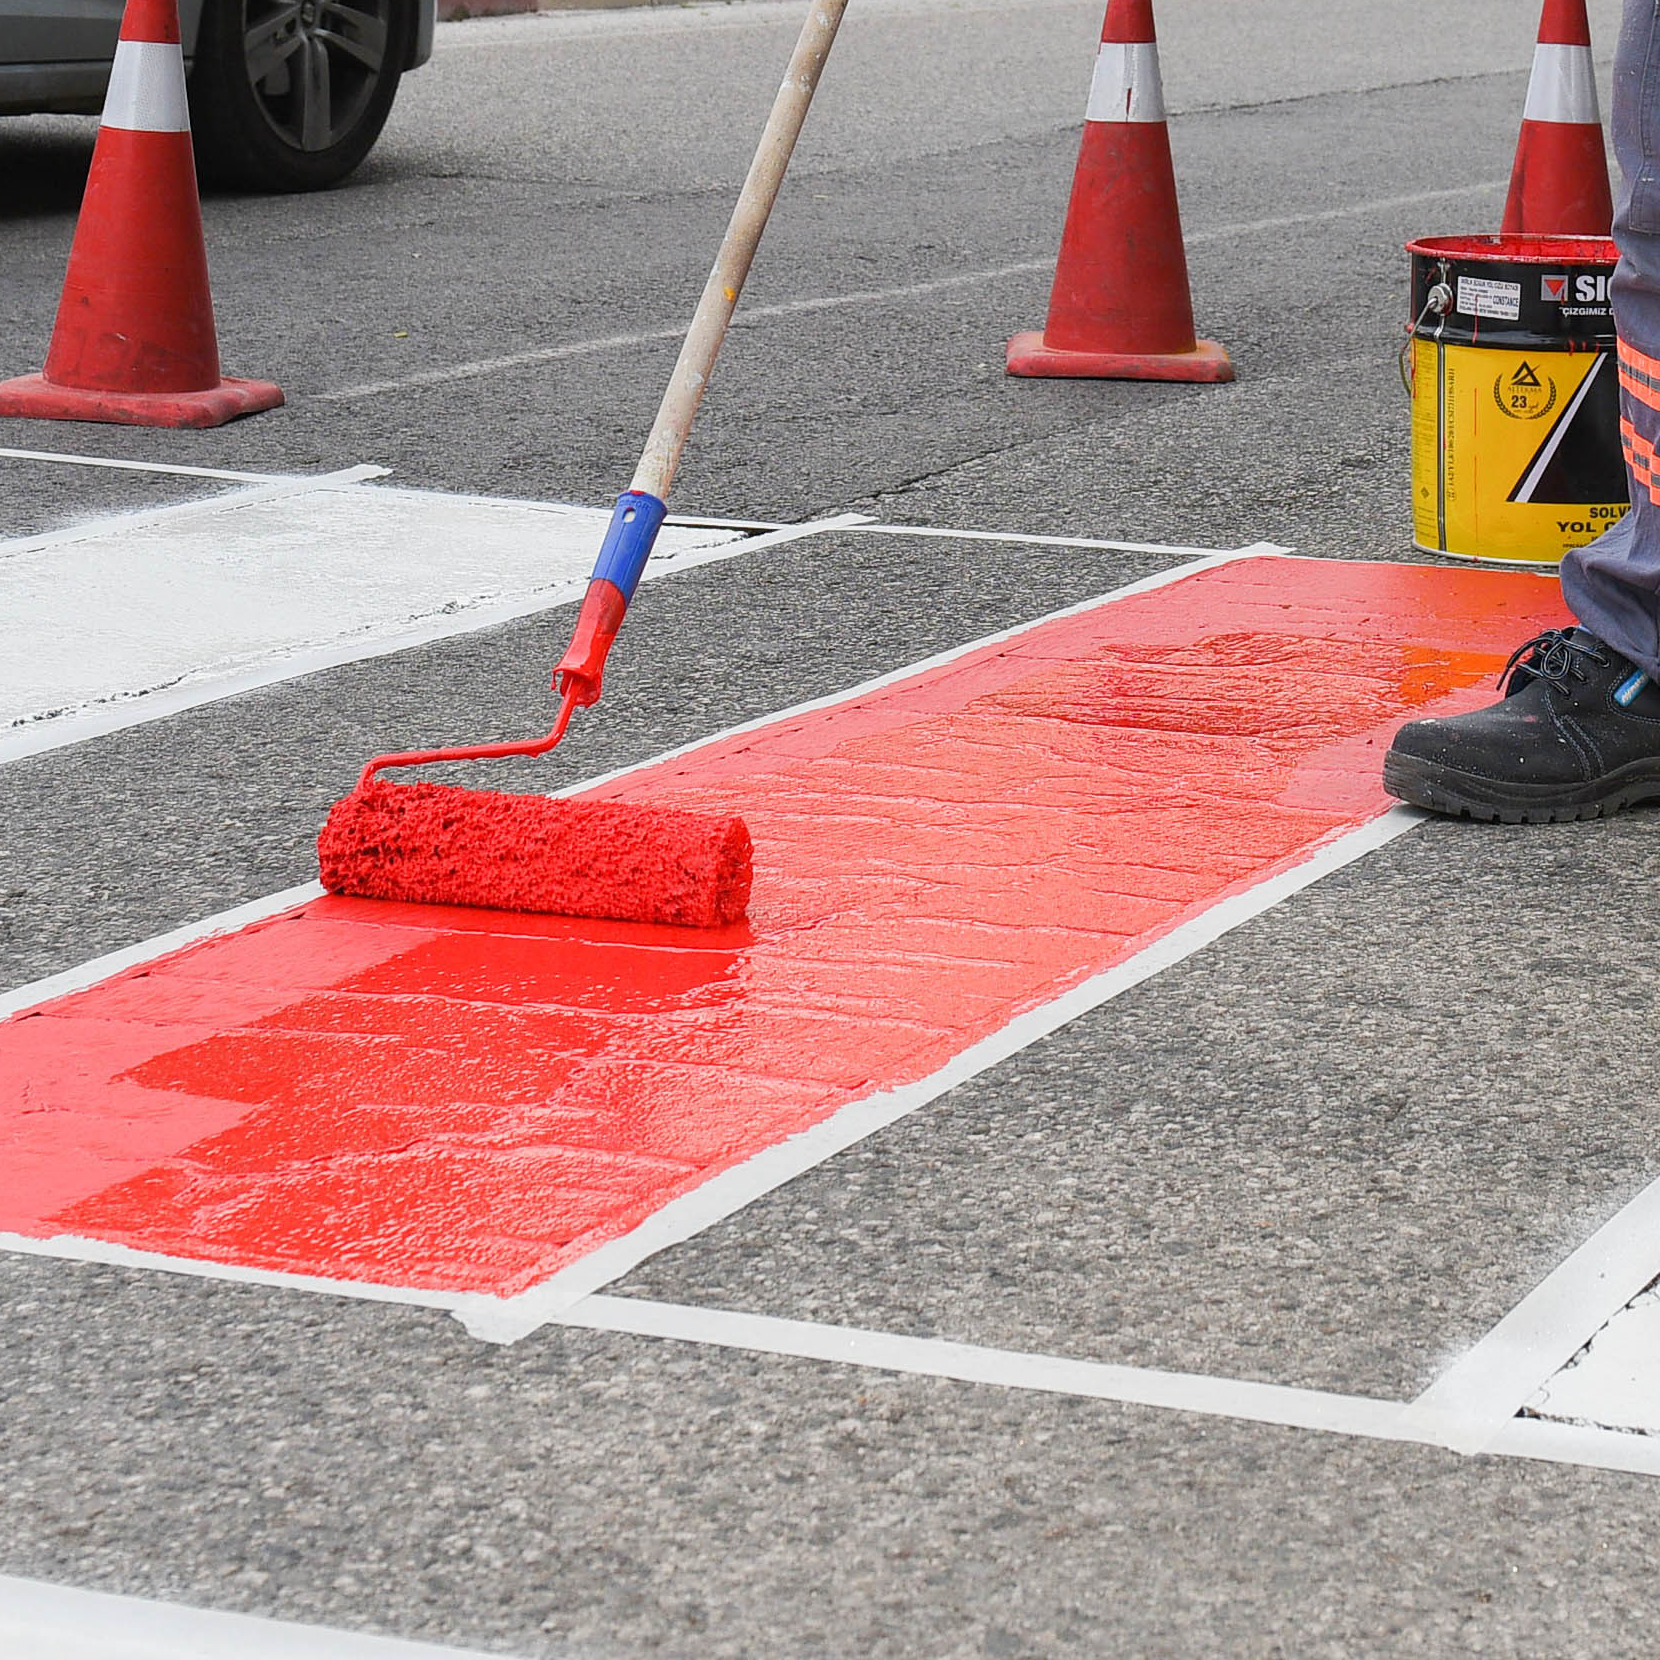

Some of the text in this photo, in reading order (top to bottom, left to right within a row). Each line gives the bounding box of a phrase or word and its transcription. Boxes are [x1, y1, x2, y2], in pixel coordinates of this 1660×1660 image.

[1576, 275, 1614, 301] SI
[1511, 395, 1527, 408] 23
[1557, 522, 1596, 532] YOL
